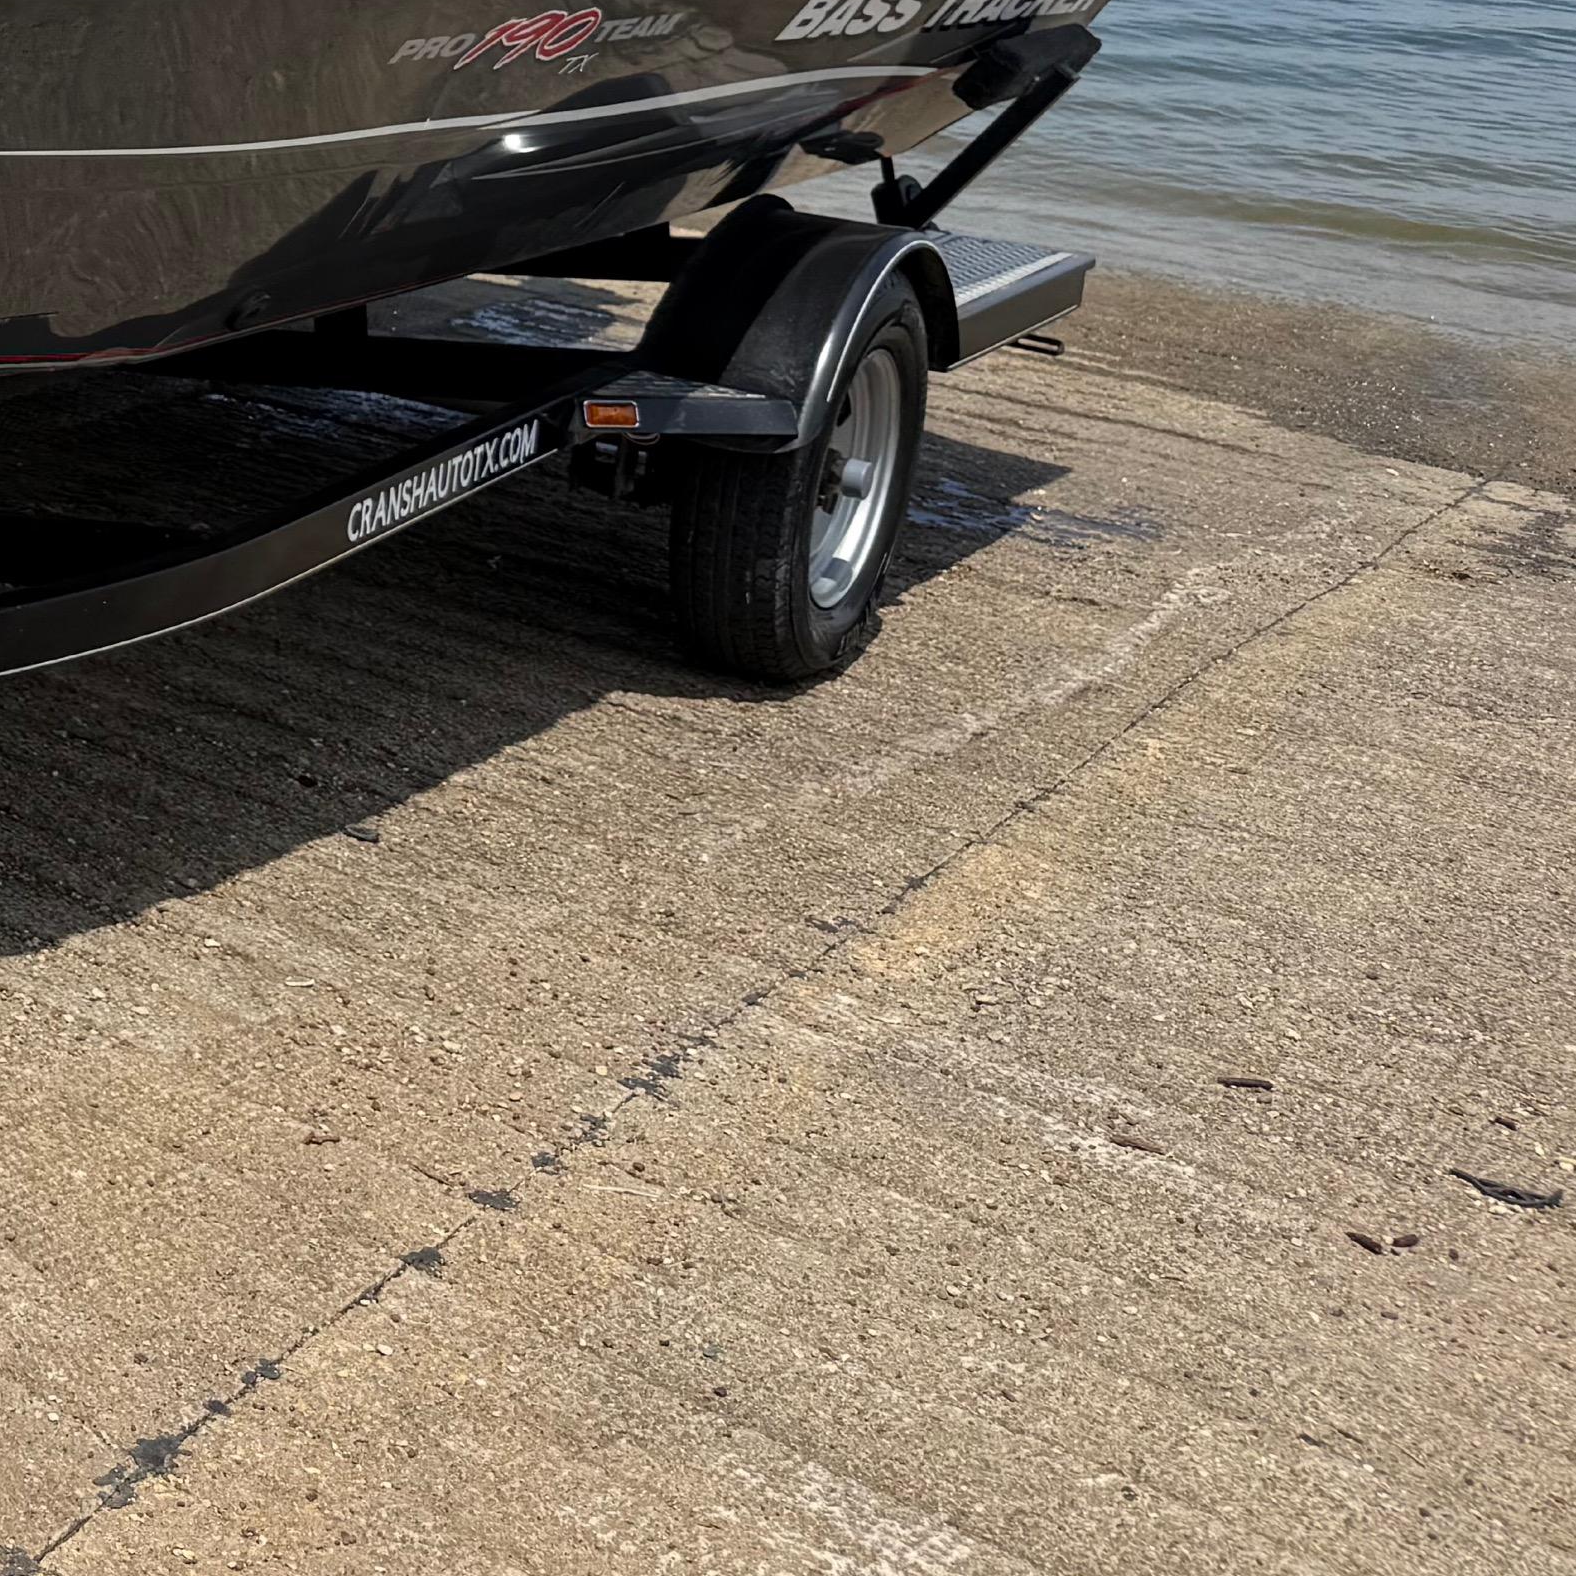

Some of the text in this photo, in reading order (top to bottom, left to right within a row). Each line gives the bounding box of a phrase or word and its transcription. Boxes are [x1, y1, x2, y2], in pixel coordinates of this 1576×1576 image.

[387, 7, 683, 70] PRO 190 TEAM
[558, 52, 599, 74] TX
[347, 419, 539, 542] CRANSHAUTOTX.COM
